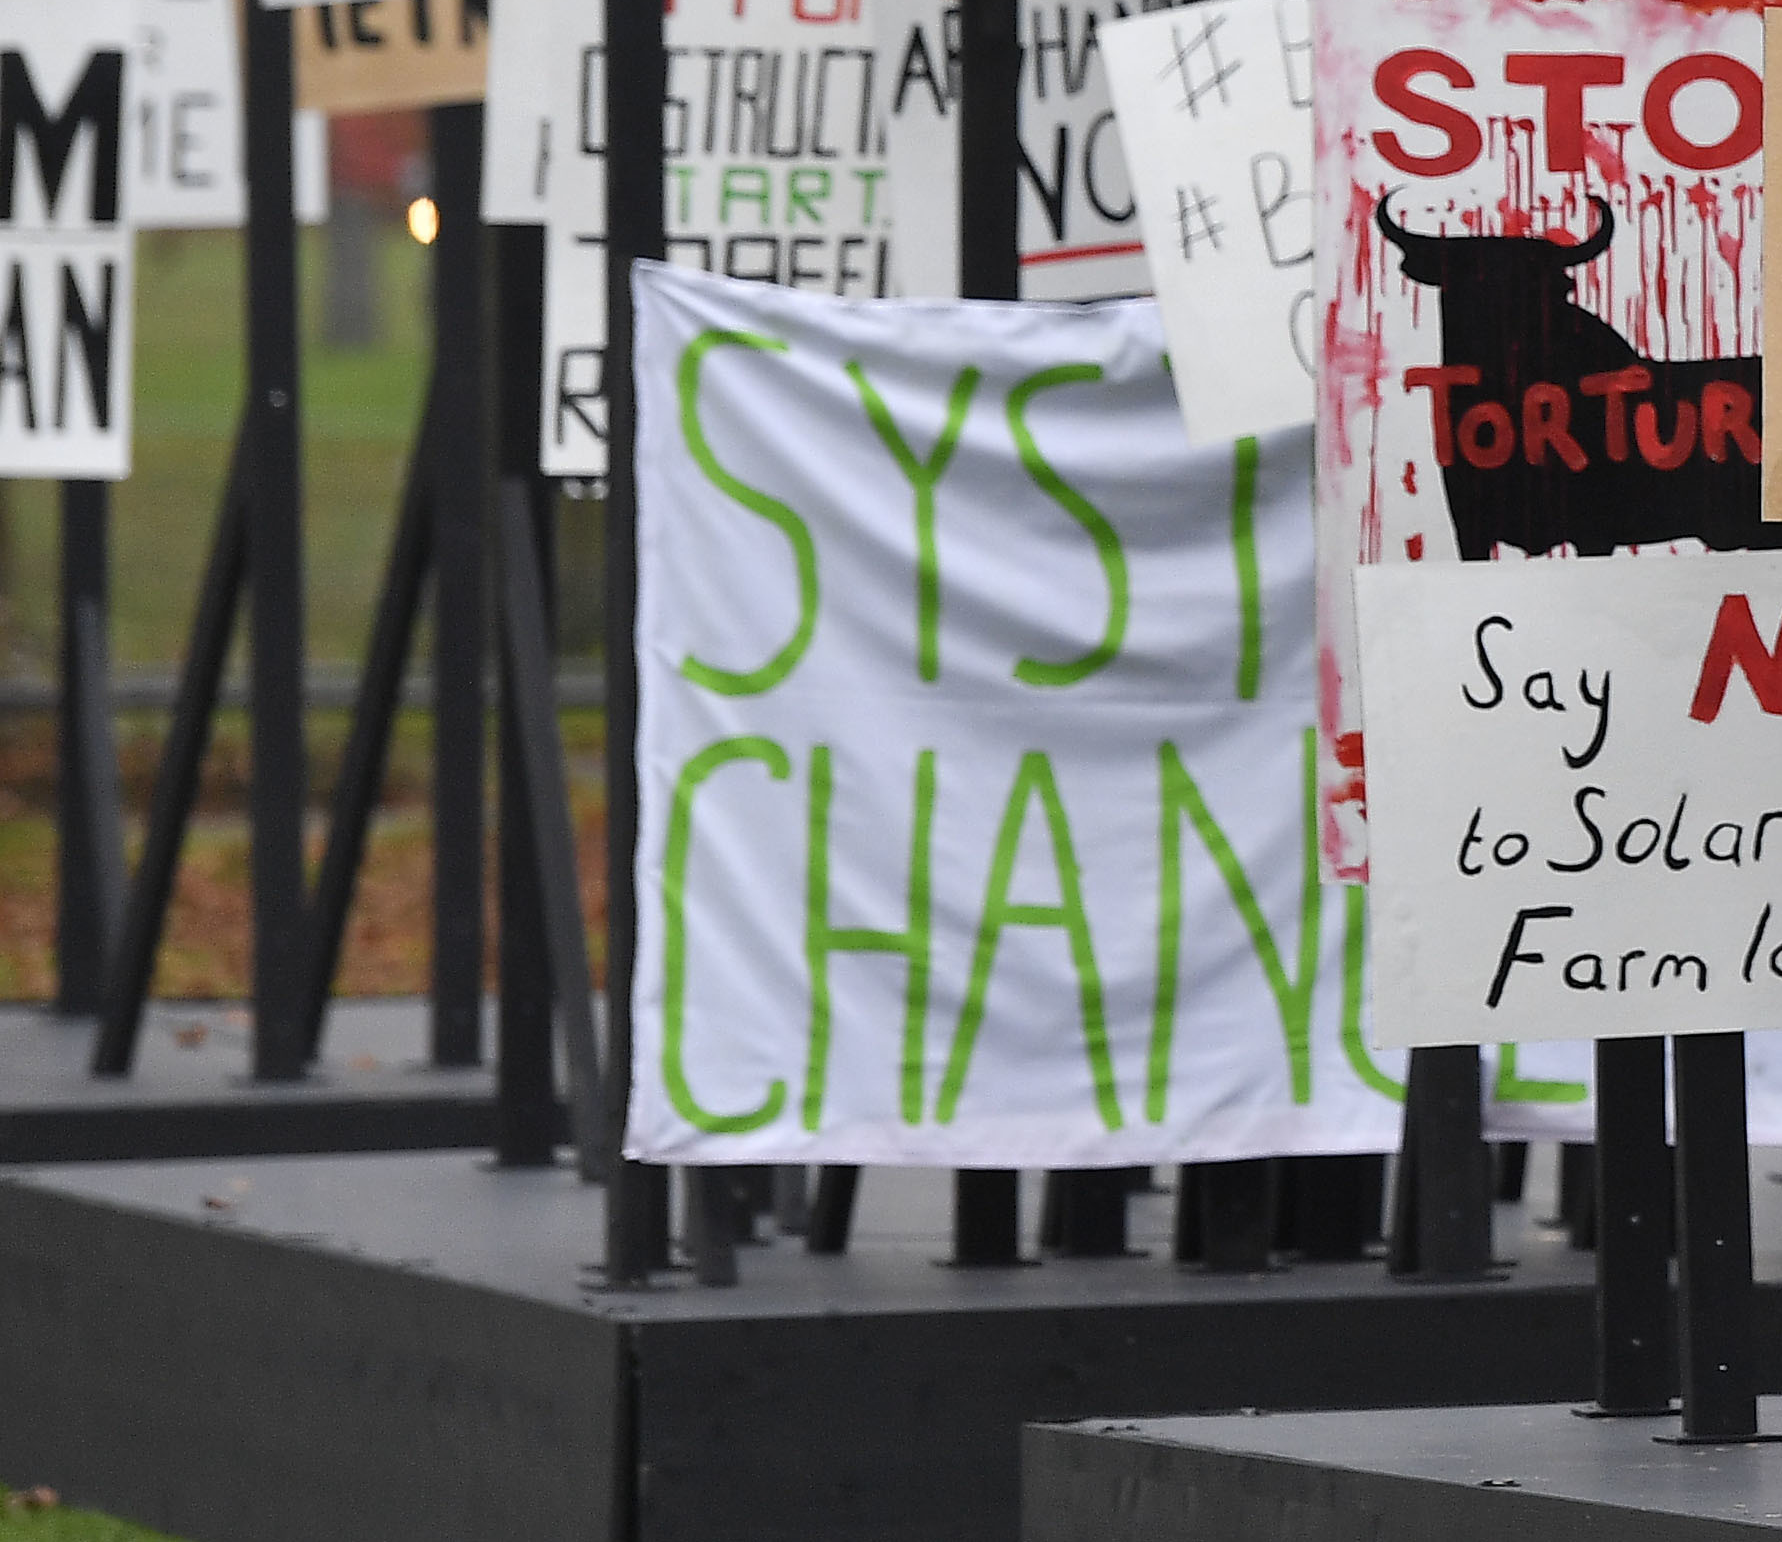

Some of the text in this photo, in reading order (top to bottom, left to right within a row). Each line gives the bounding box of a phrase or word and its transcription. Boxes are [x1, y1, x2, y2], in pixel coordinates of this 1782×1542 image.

[1371, 48, 1764, 178] STO
[1461, 614, 1611, 770] Say
[1457, 807, 1530, 877] to
